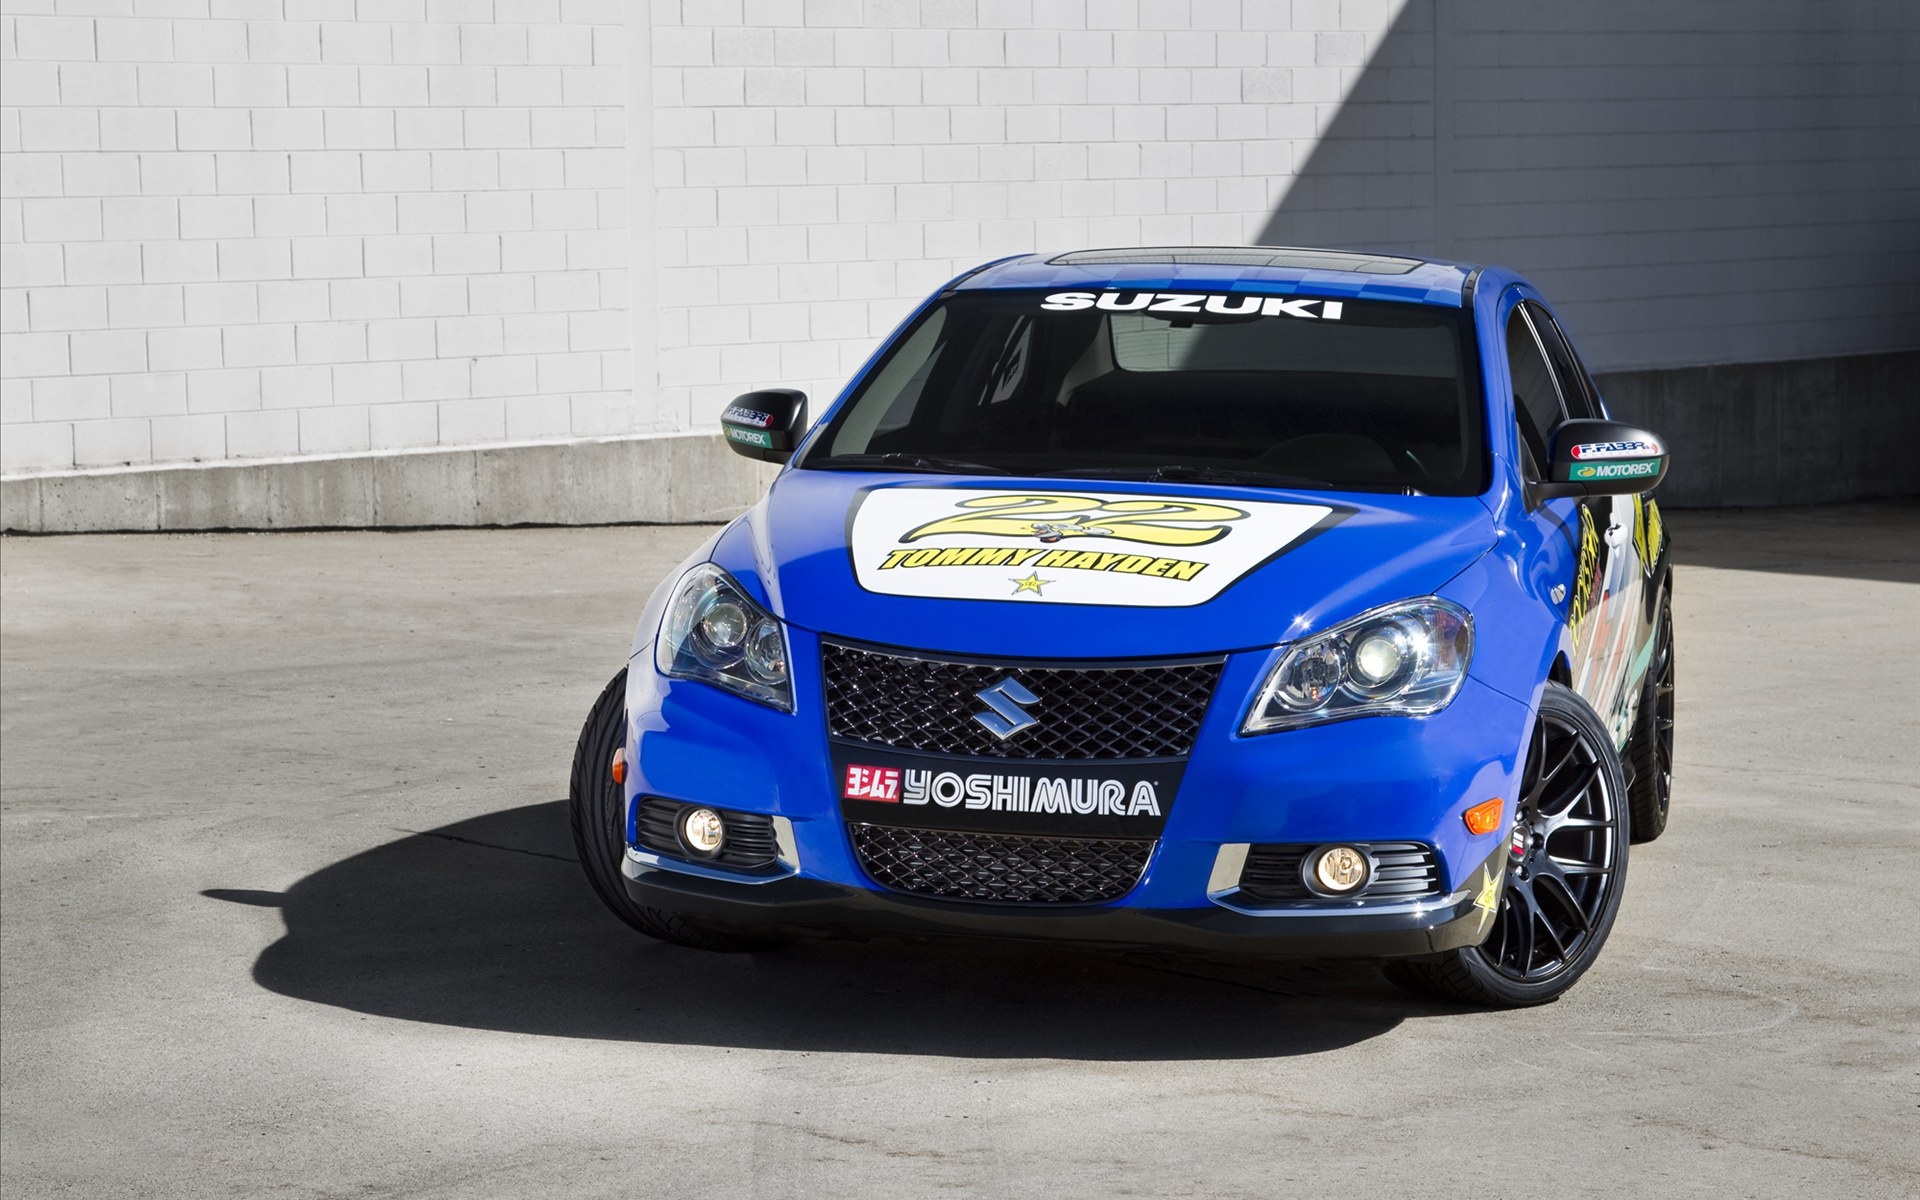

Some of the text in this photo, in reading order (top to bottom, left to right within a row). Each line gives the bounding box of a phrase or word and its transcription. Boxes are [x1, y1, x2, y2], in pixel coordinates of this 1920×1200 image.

[1041, 292, 1343, 319] SUZUKI
[730, 427, 766, 445] MOTOREX
[1596, 462, 1653, 477] MOTOREX
[898, 494, 1251, 547] 22
[877, 547, 1210, 582] TOMMY HAYDEN
[903, 768, 1161, 817] YOSHIMURA
